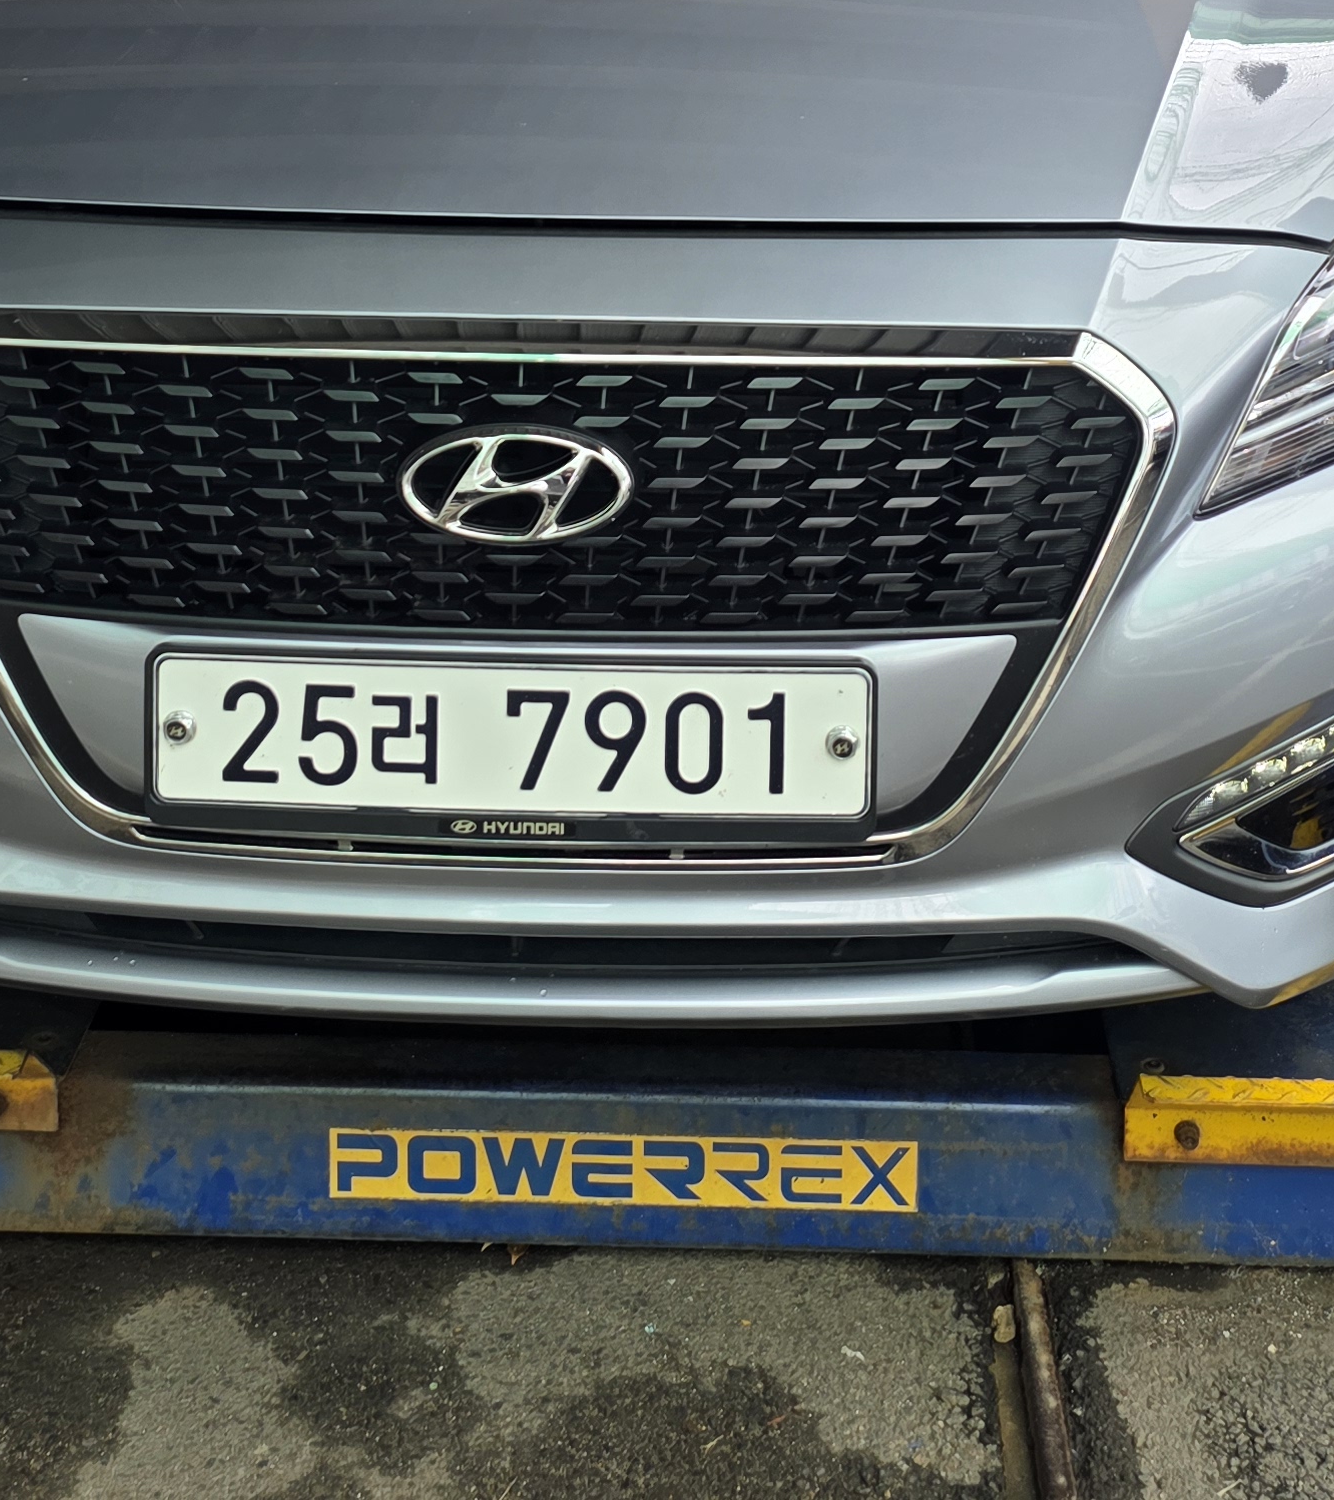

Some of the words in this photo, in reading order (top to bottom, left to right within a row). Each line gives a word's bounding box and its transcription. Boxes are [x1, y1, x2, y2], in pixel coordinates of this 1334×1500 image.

[221, 679, 438, 787] 25러
[505, 688, 787, 796] 7901
[482, 820, 565, 836] HYUNDAI
[336, 1132, 911, 1207] POWERREX
